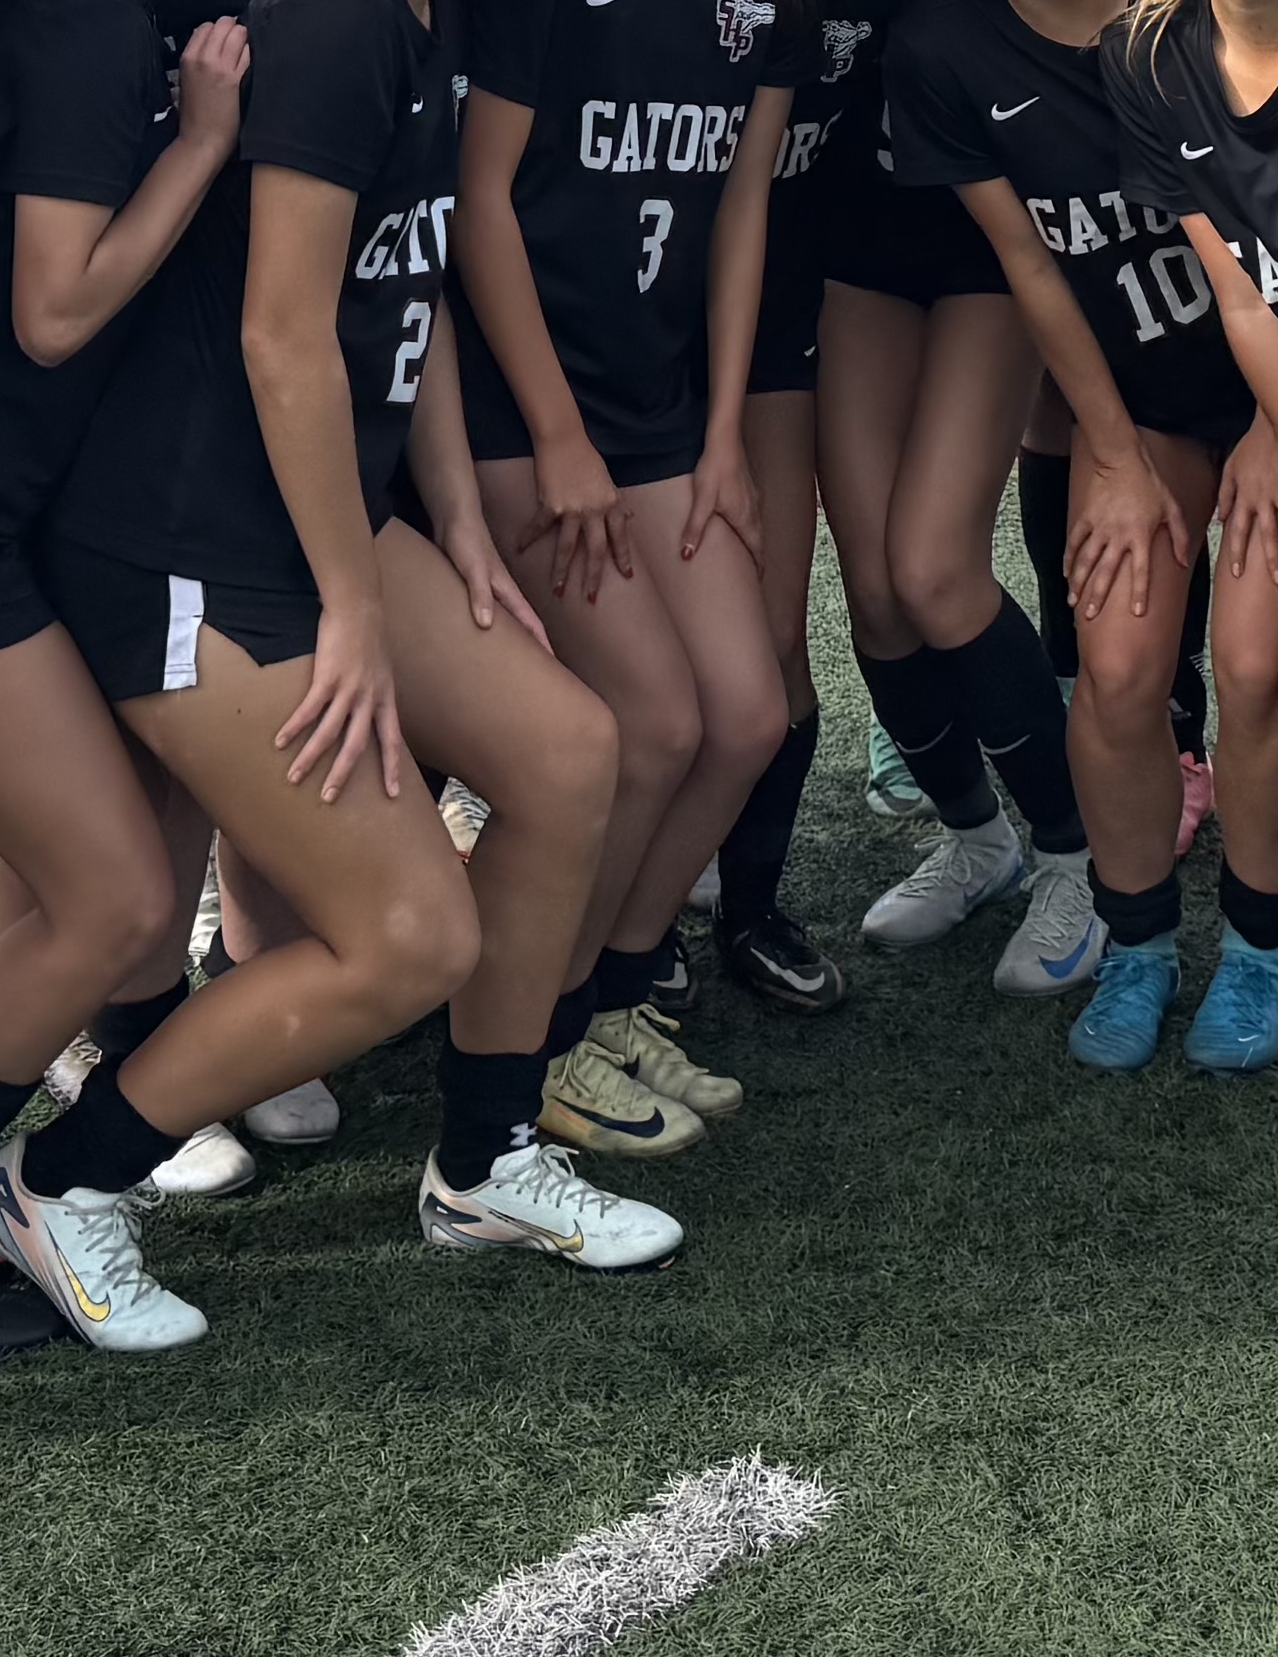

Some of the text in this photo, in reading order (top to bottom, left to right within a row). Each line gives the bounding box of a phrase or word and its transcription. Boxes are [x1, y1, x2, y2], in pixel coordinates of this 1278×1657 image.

[579, 99, 746, 173] GATORS
[637, 198, 675, 294] 3
[1116, 245, 1213, 343] 10
[386, 301, 432, 403] 2
